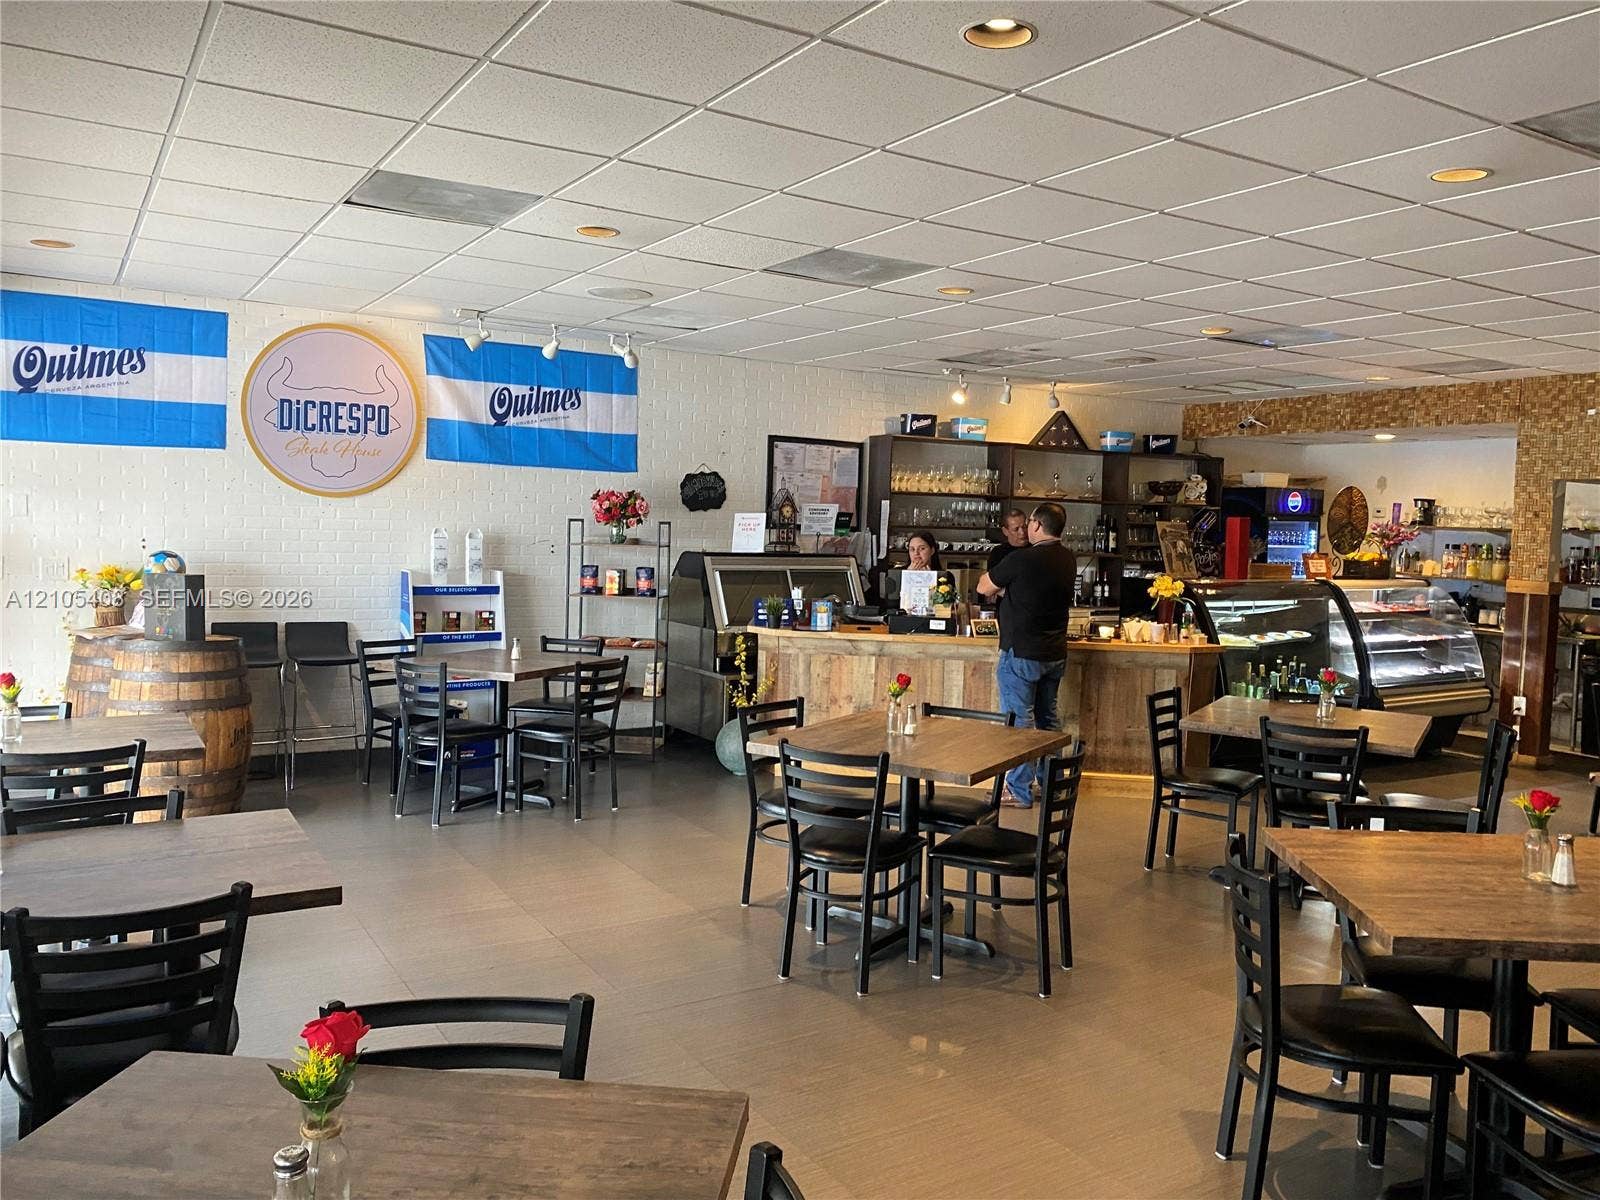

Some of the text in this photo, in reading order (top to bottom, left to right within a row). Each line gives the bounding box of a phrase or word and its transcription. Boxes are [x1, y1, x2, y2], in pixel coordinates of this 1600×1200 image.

[13, 344, 146, 394] Quilmes
[45, 381, 130, 393] CERVEZA ARGENTINA
[489, 385, 581, 427] Quilmes
[284, 436, 383, 459] Steak House
